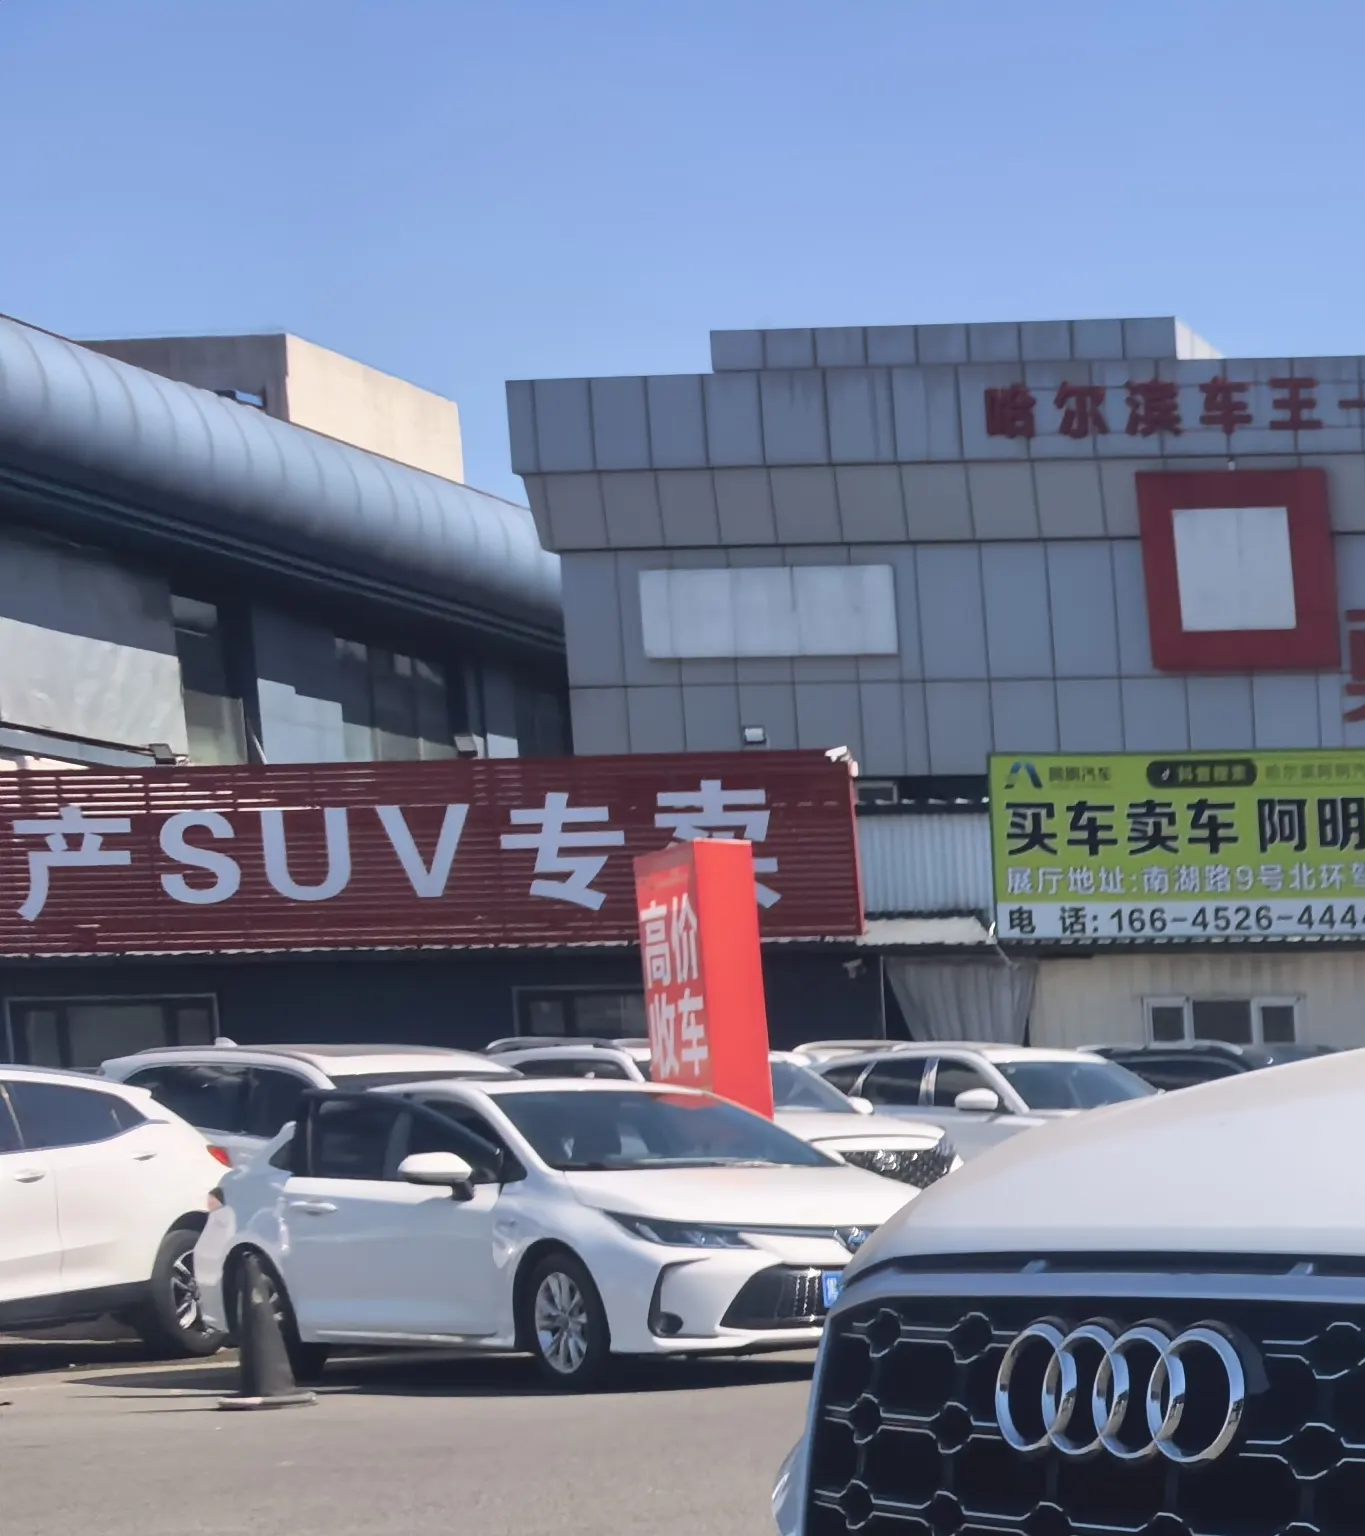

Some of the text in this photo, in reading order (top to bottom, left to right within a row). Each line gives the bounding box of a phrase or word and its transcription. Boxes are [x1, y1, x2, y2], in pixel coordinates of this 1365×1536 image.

[1004, 799, 1239, 857] 买车卖车
[639, 892, 699, 989] 高价
[649, 987, 710, 1080] 收车
